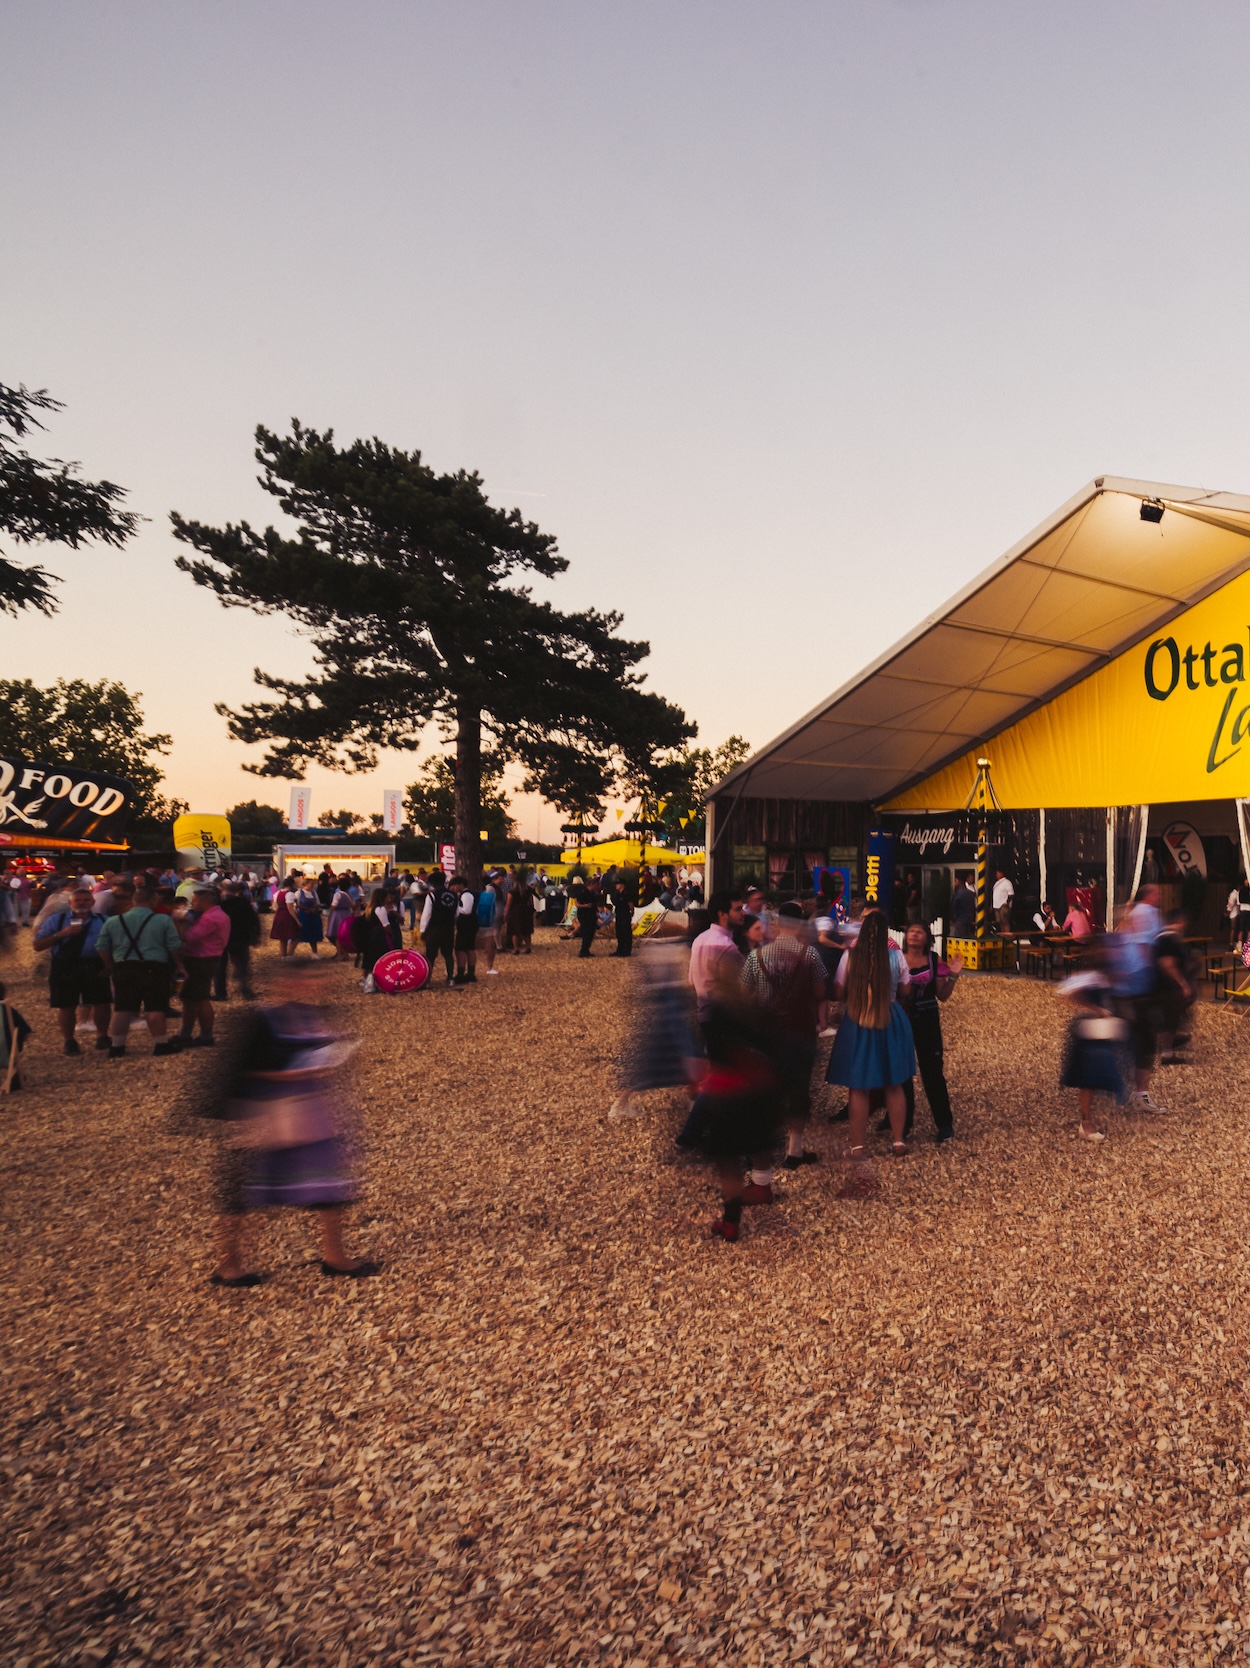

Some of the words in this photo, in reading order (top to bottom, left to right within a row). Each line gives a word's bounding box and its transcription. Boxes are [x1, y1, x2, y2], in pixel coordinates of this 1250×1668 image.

[19, 768, 124, 816] FOOD
[901, 822, 954, 855] Ausgang
[865, 855, 880, 902] oletti
[385, 959, 416, 971] NORDIC
